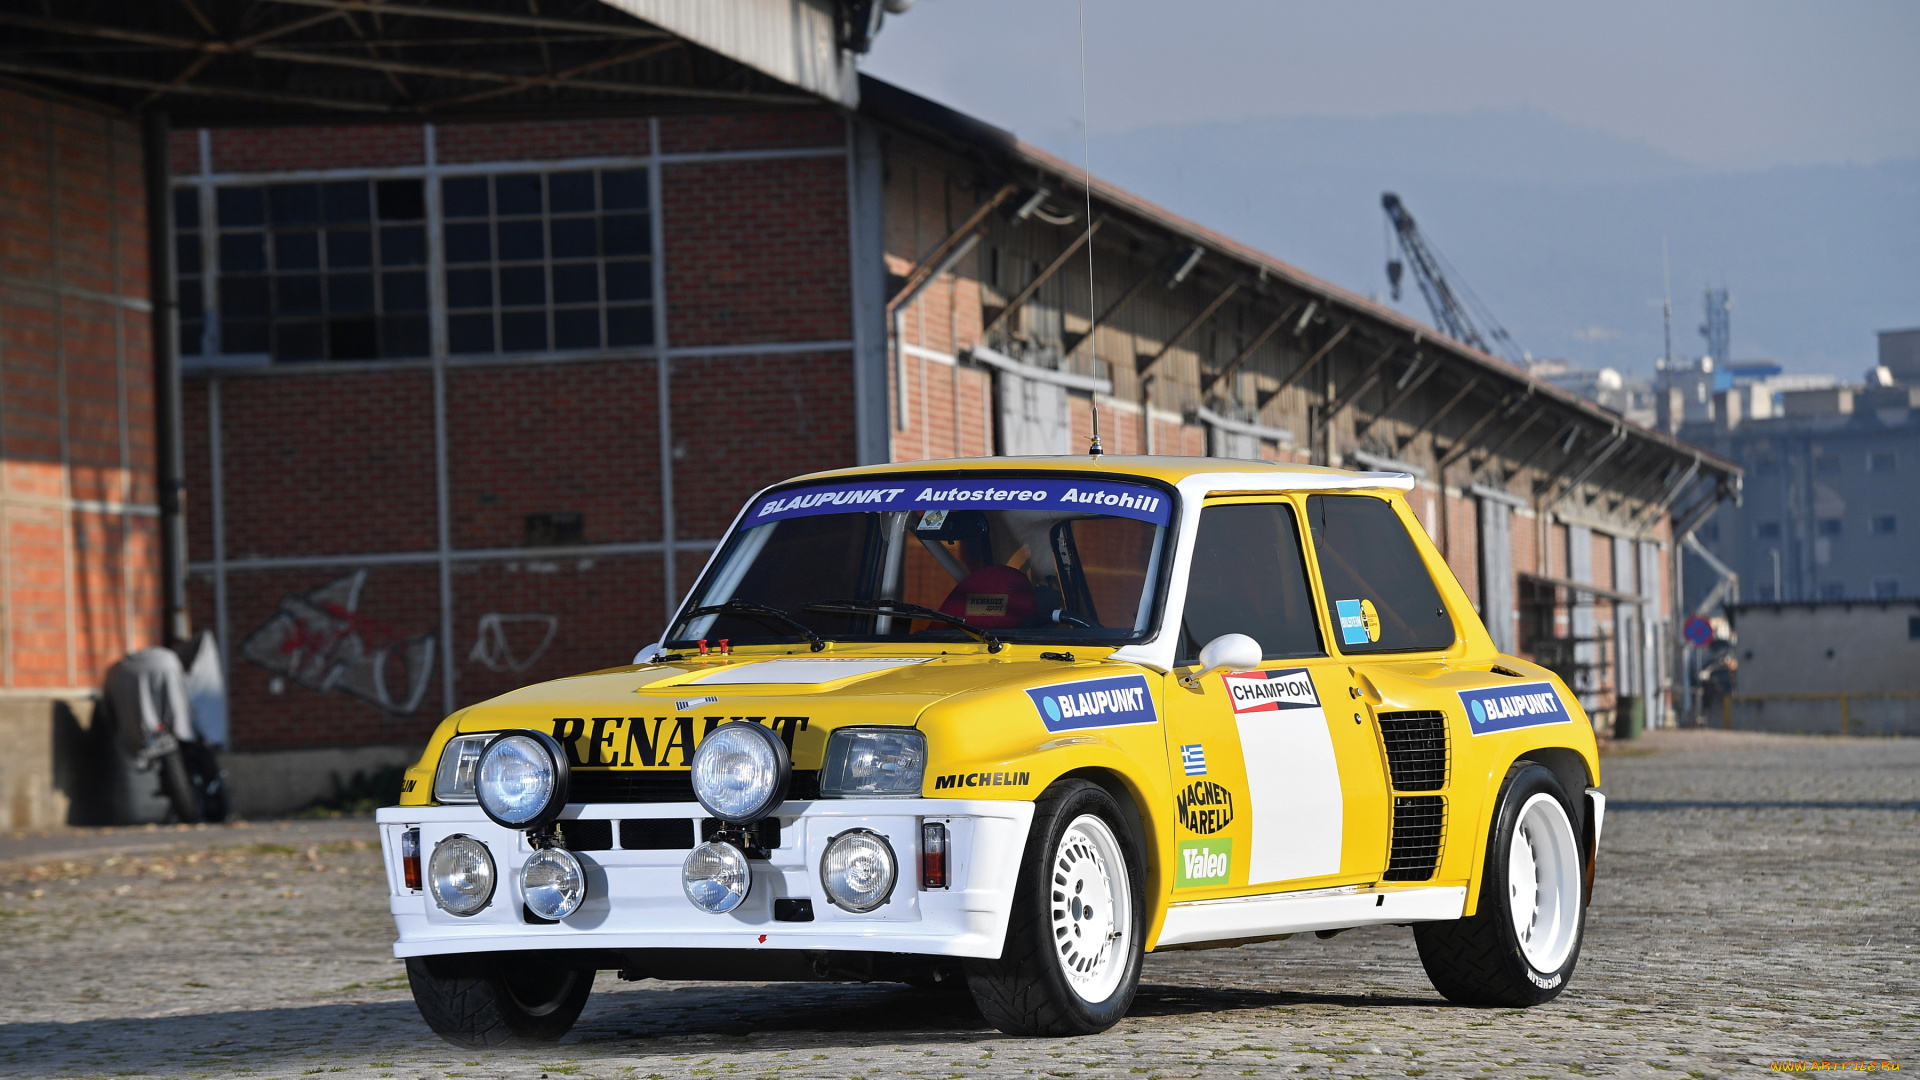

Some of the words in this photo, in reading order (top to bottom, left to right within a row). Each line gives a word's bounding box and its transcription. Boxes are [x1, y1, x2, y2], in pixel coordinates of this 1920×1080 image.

[757, 488, 905, 518] BLAUPUNKT
[914, 487, 1048, 502] Autostereo
[1059, 487, 1160, 513] Autohill
[1058, 686, 1145, 718] BLAUPUNKT
[1232, 680, 1312, 701] CHAMPION
[1482, 692, 1558, 721] BLAUPUNKT
[551, 716, 810, 767] RENAT
[934, 771, 1030, 790] MICHELIN
[1176, 780, 1233, 814] MAGNETI
[1178, 803, 1234, 835] MARELLI
[1182, 847, 1227, 879] Valeo
[1526, 967, 1562, 990] MICHELIN
